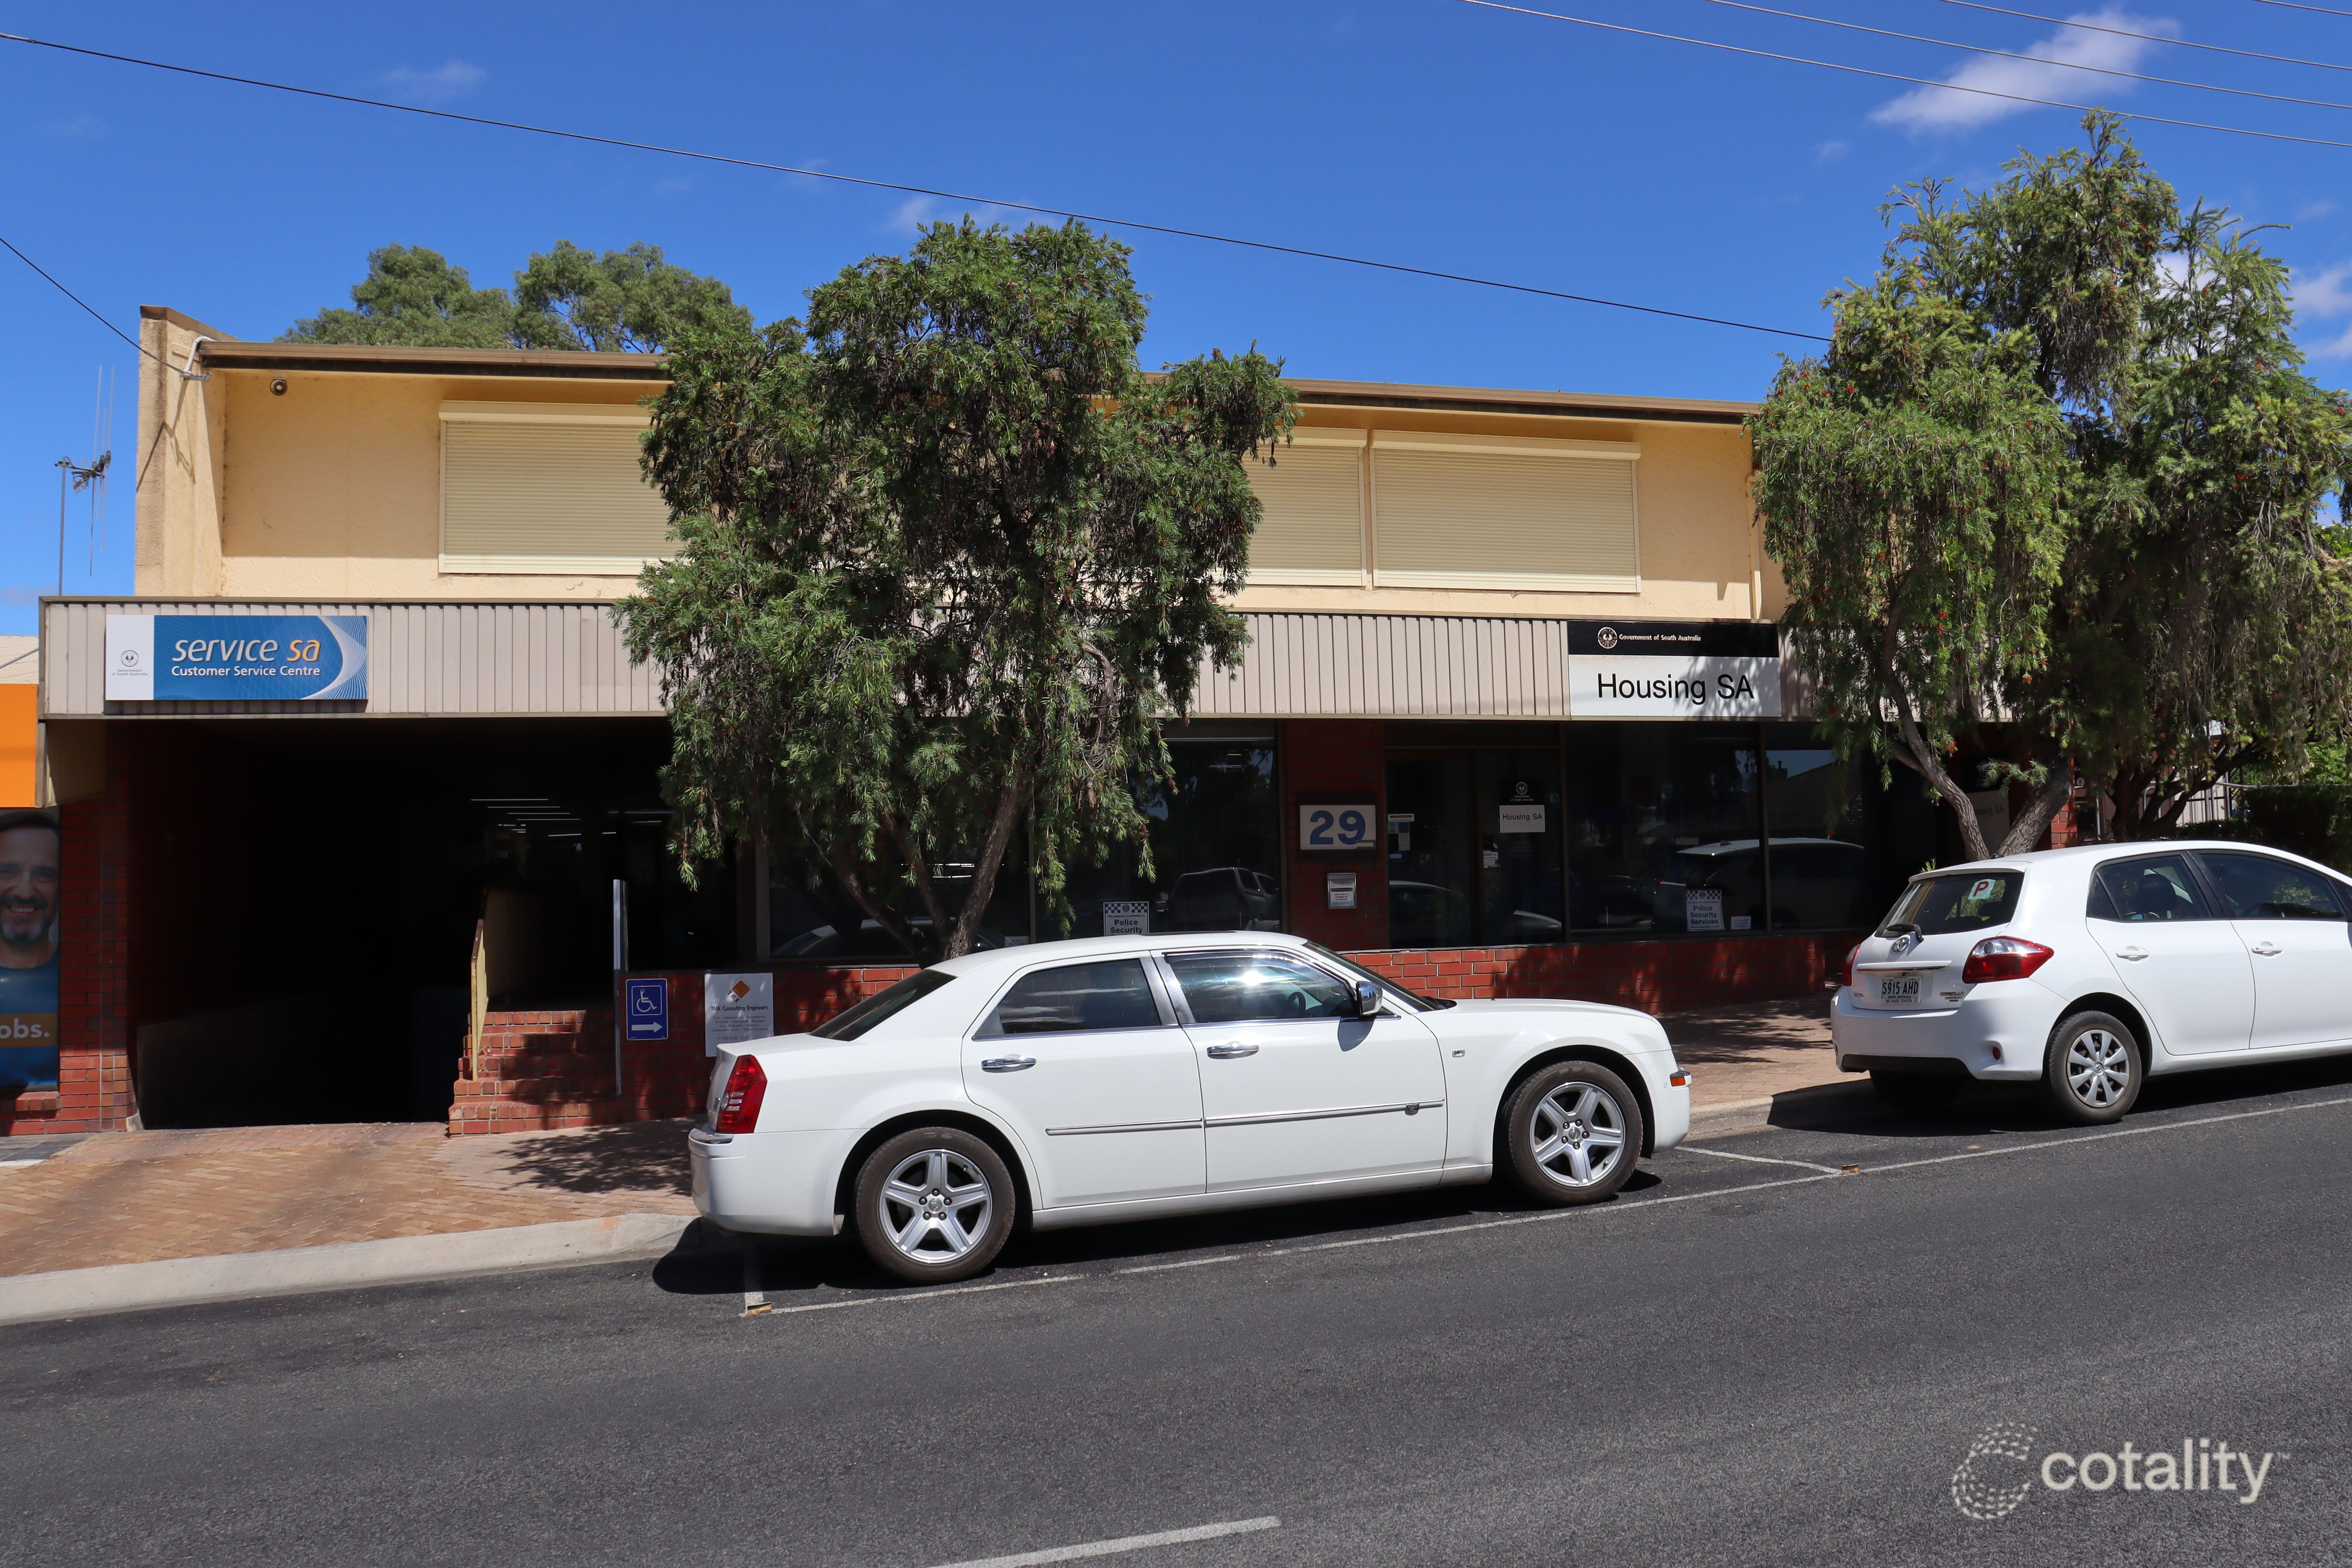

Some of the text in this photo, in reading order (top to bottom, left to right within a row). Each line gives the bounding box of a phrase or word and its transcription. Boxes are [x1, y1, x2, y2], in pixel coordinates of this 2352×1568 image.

[172, 639, 320, 662] service sa
[172, 666, 320, 676] Customer Service Centre
[1598, 673, 1754, 705] Housing SA
[1310, 810, 1366, 845] 29
[1973, 881, 1989, 897] P
[1882, 981, 1918, 995] S915-AHD
[727, 991, 740, 1003] TMK
